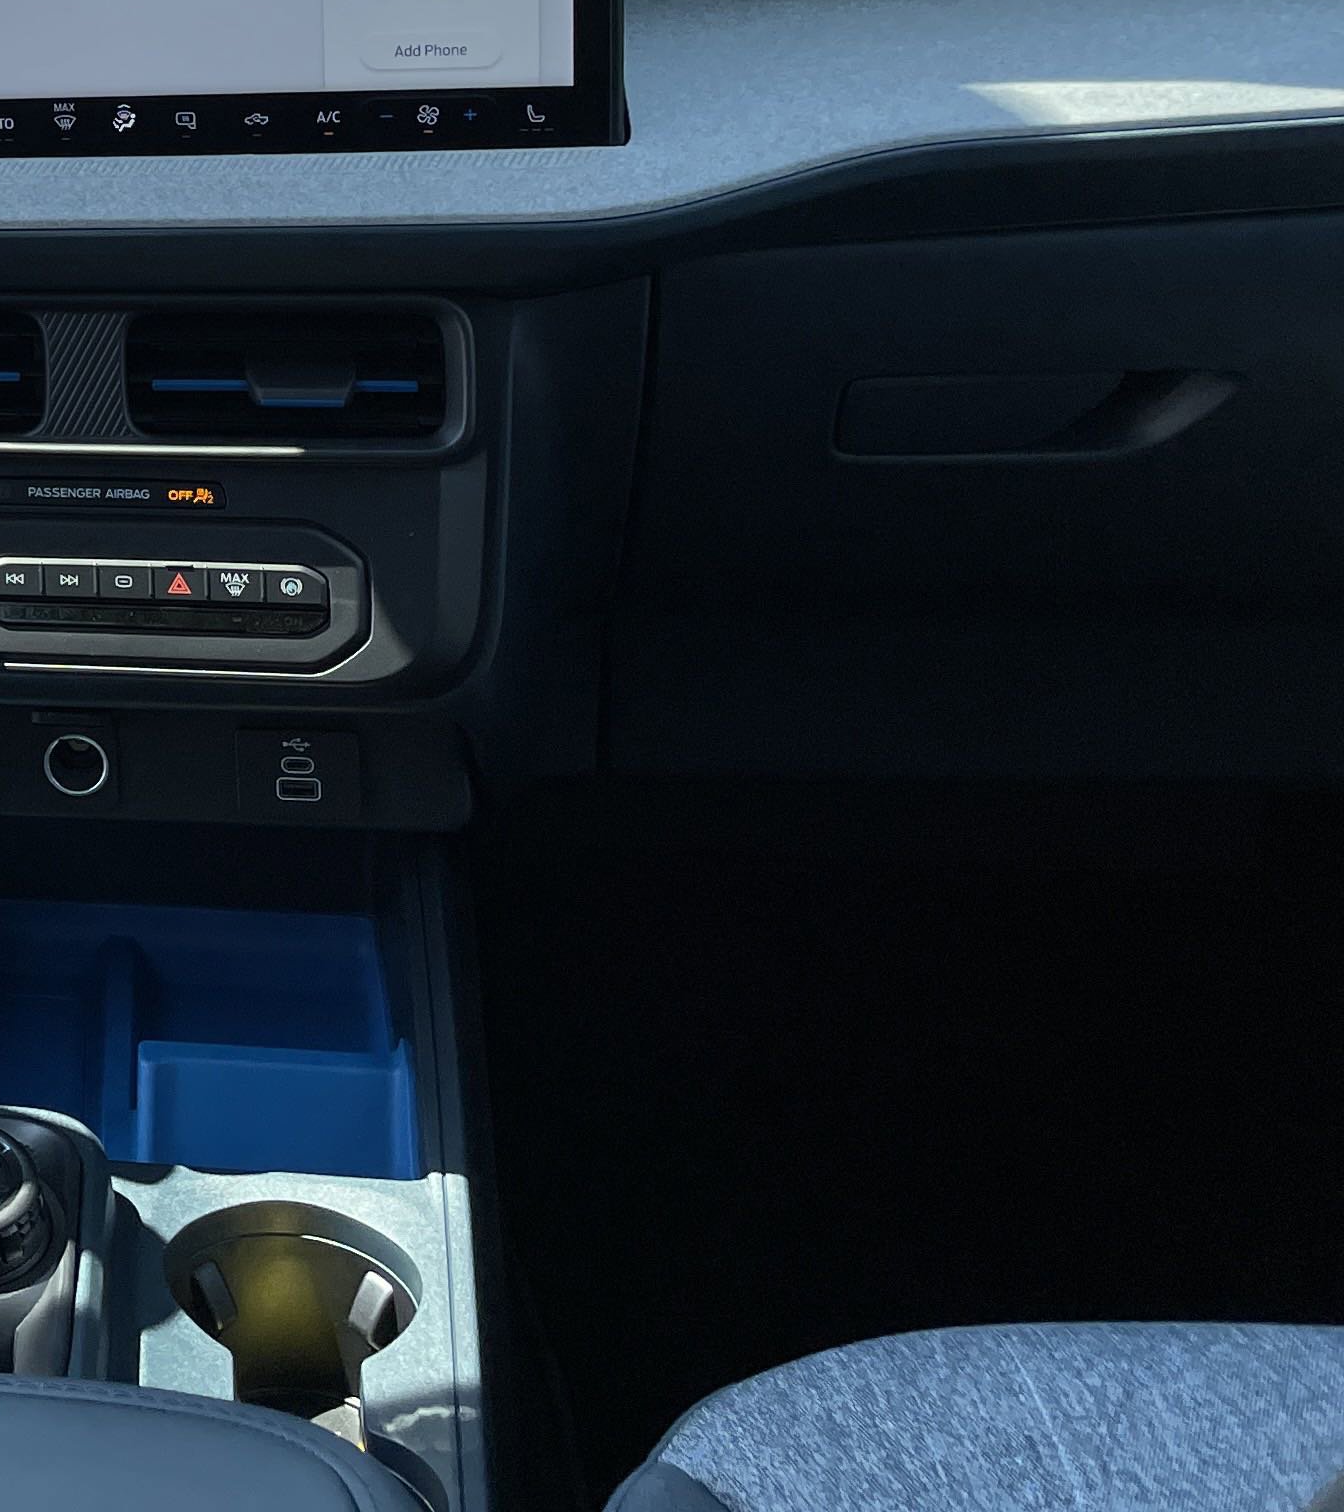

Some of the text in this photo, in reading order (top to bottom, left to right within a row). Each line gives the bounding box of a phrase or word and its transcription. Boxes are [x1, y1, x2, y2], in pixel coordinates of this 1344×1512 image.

[394, 44, 468, 58] Add Phone
[53, 103, 76, 113] MAX
[316, 110, 341, 124] A/C
[27, 486, 101, 499] PASSENGER
[104, 487, 151, 500] AIRBAG
[167, 489, 194, 501] OFF
[220, 573, 250, 585] MAX
